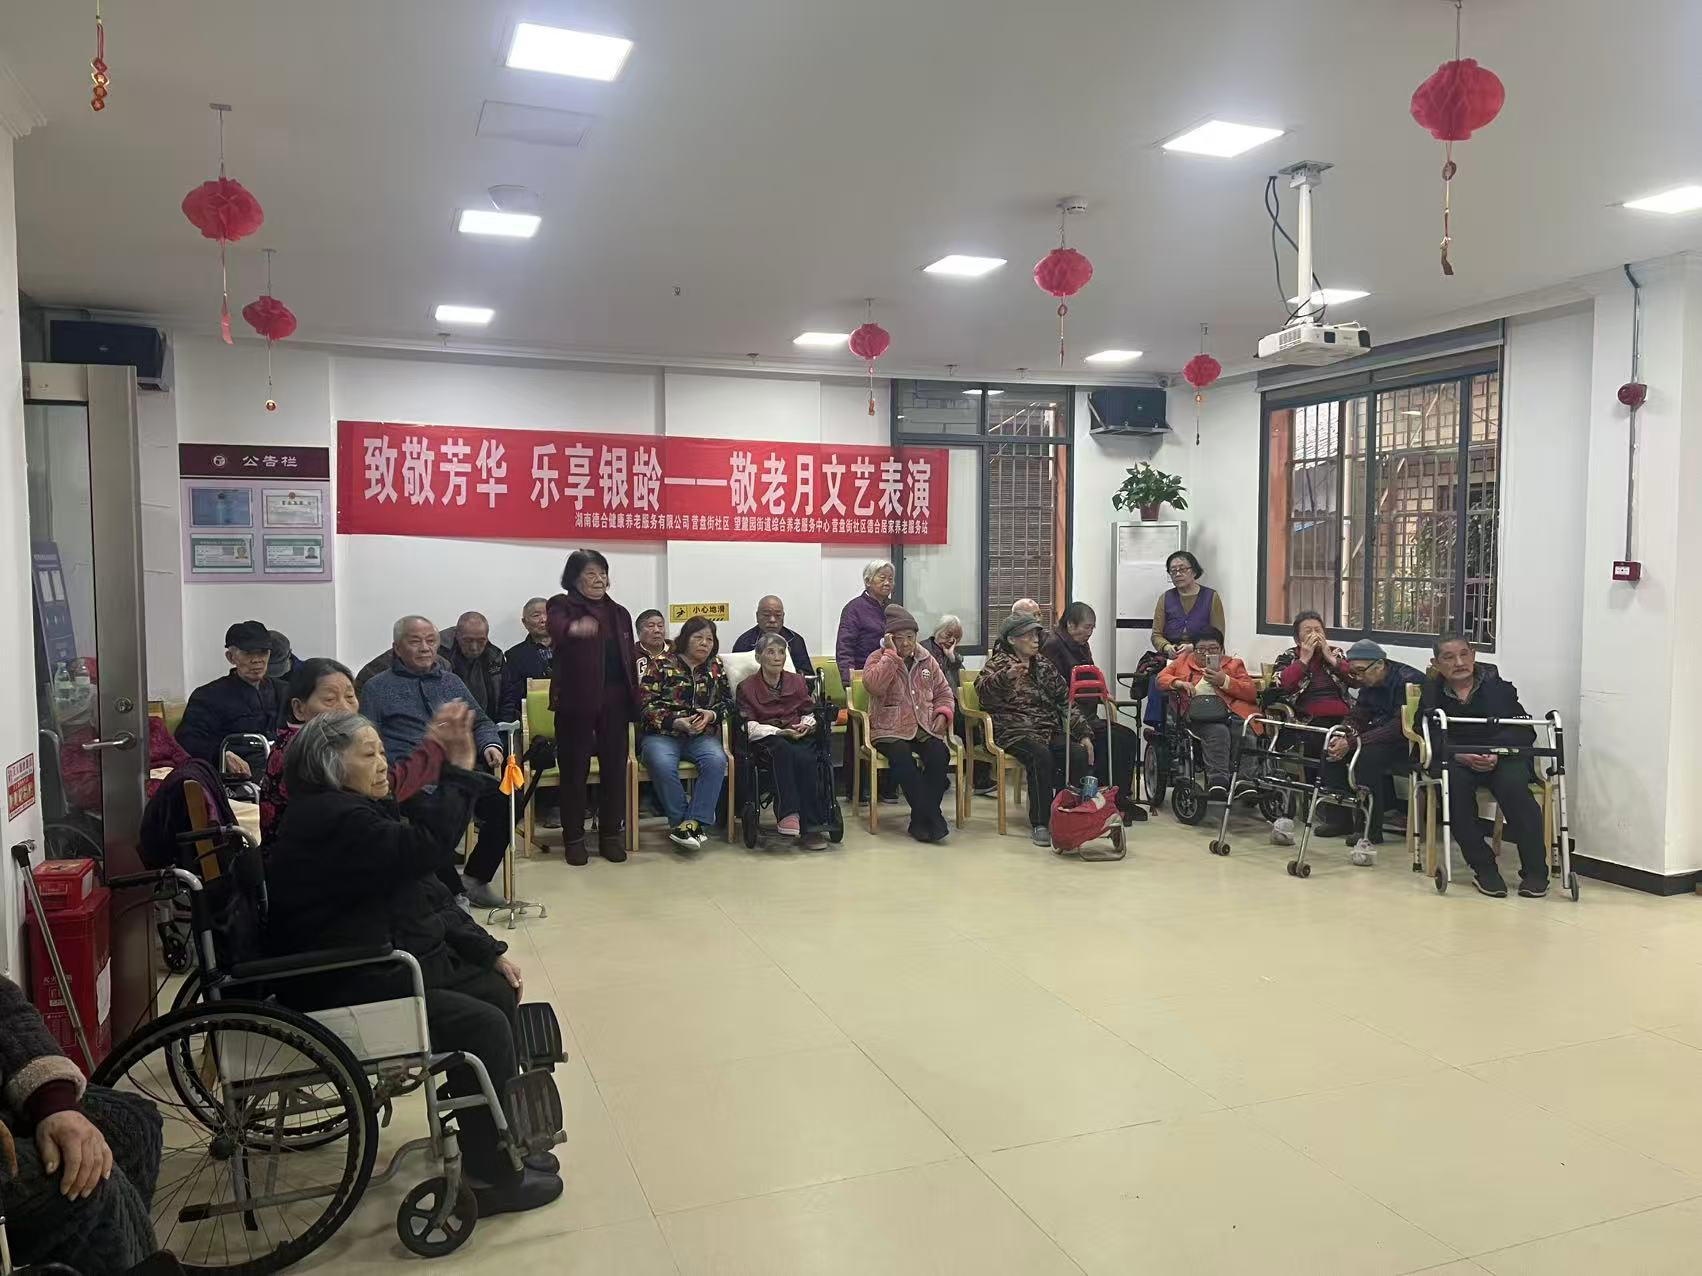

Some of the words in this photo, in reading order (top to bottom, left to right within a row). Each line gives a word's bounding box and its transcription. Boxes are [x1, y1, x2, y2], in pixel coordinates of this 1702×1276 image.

[242, 455, 298, 468] 公告栏
[364, 435, 508, 509] 致敬芳华
[575, 511, 690, 531] 湖南德合健康养老服务有限公司
[692, 514, 730, 532] 营盘街社区
[734, 515, 830, 533] 望麓园街道综合养老服务中心
[831, 518, 929, 535] 营盘街社区德合居家养老服务站
[693, 605, 725, 614] 小心地滑
